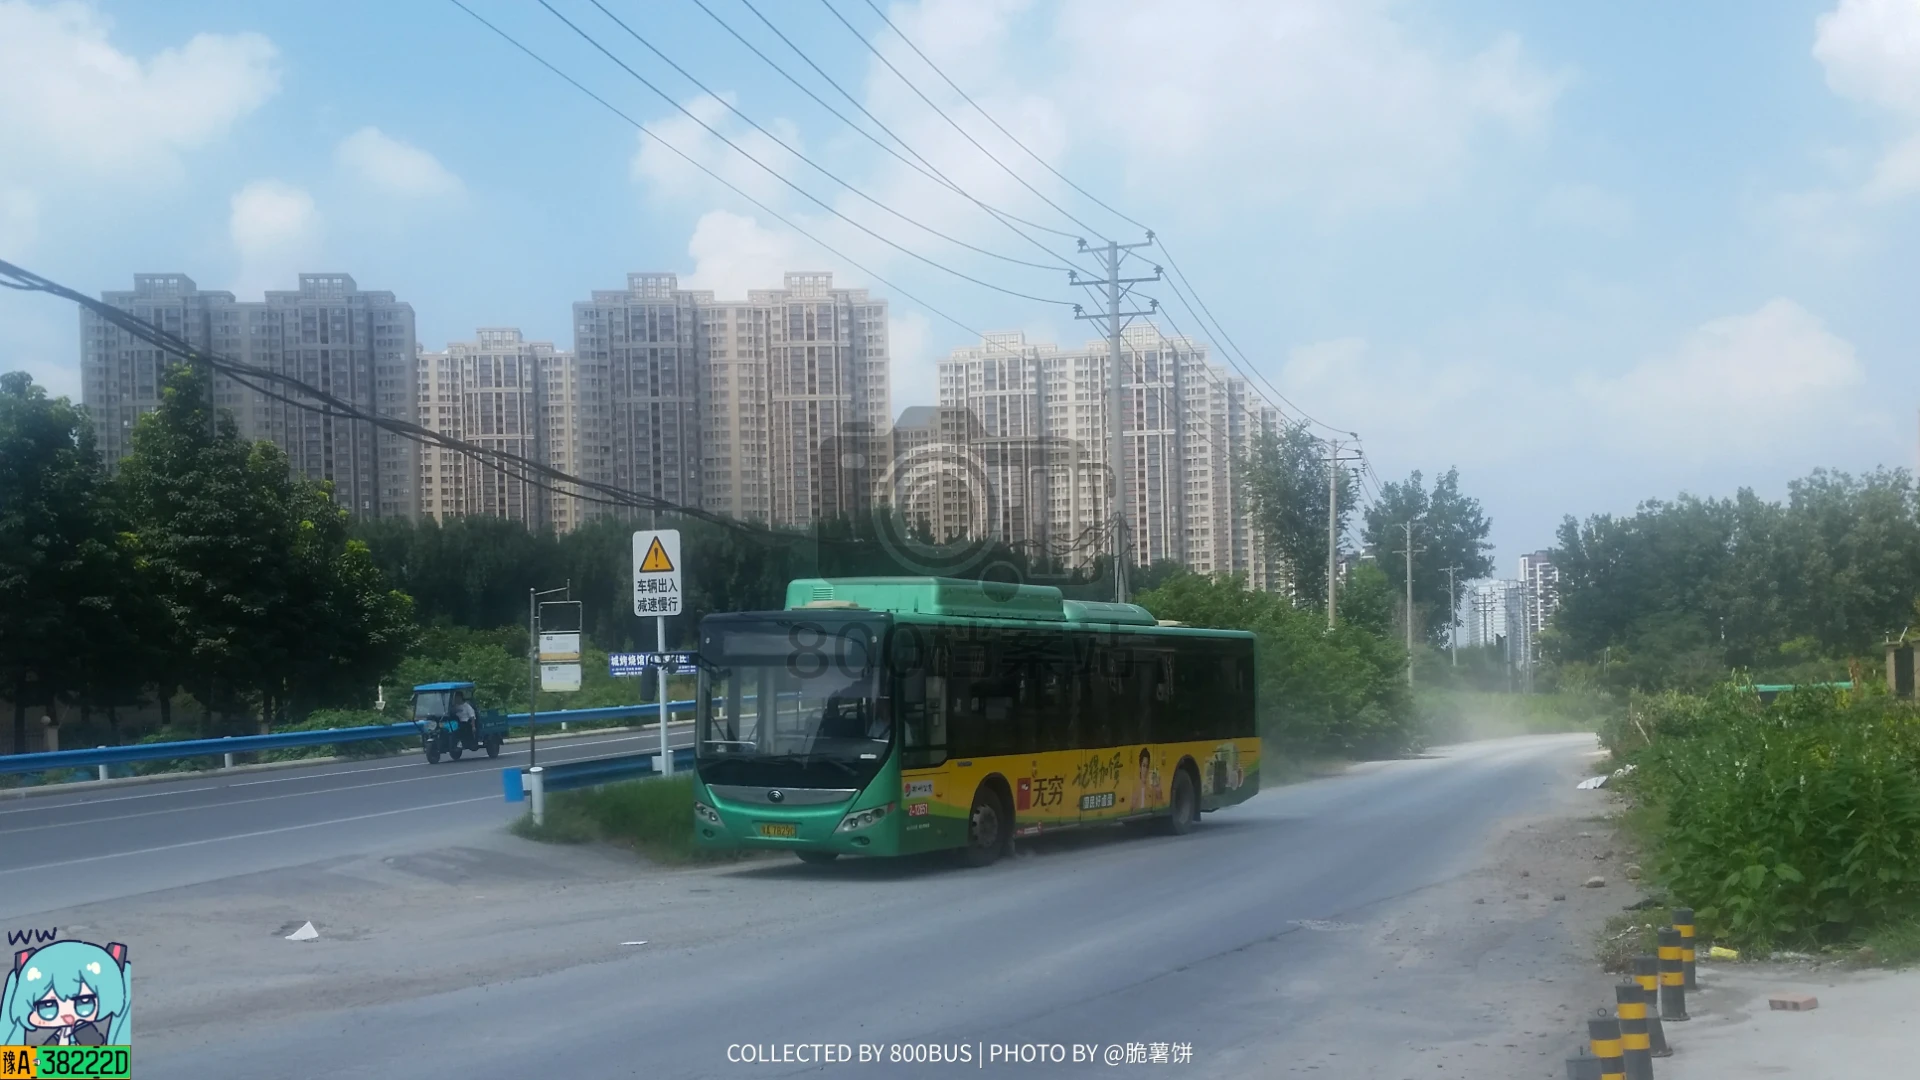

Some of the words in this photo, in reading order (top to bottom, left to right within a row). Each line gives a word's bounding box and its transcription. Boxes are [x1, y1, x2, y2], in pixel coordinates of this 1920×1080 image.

[637, 578, 678, 594] 车辆出入
[637, 597, 678, 612] 减速慢行
[1032, 775, 1064, 807] 无穷
